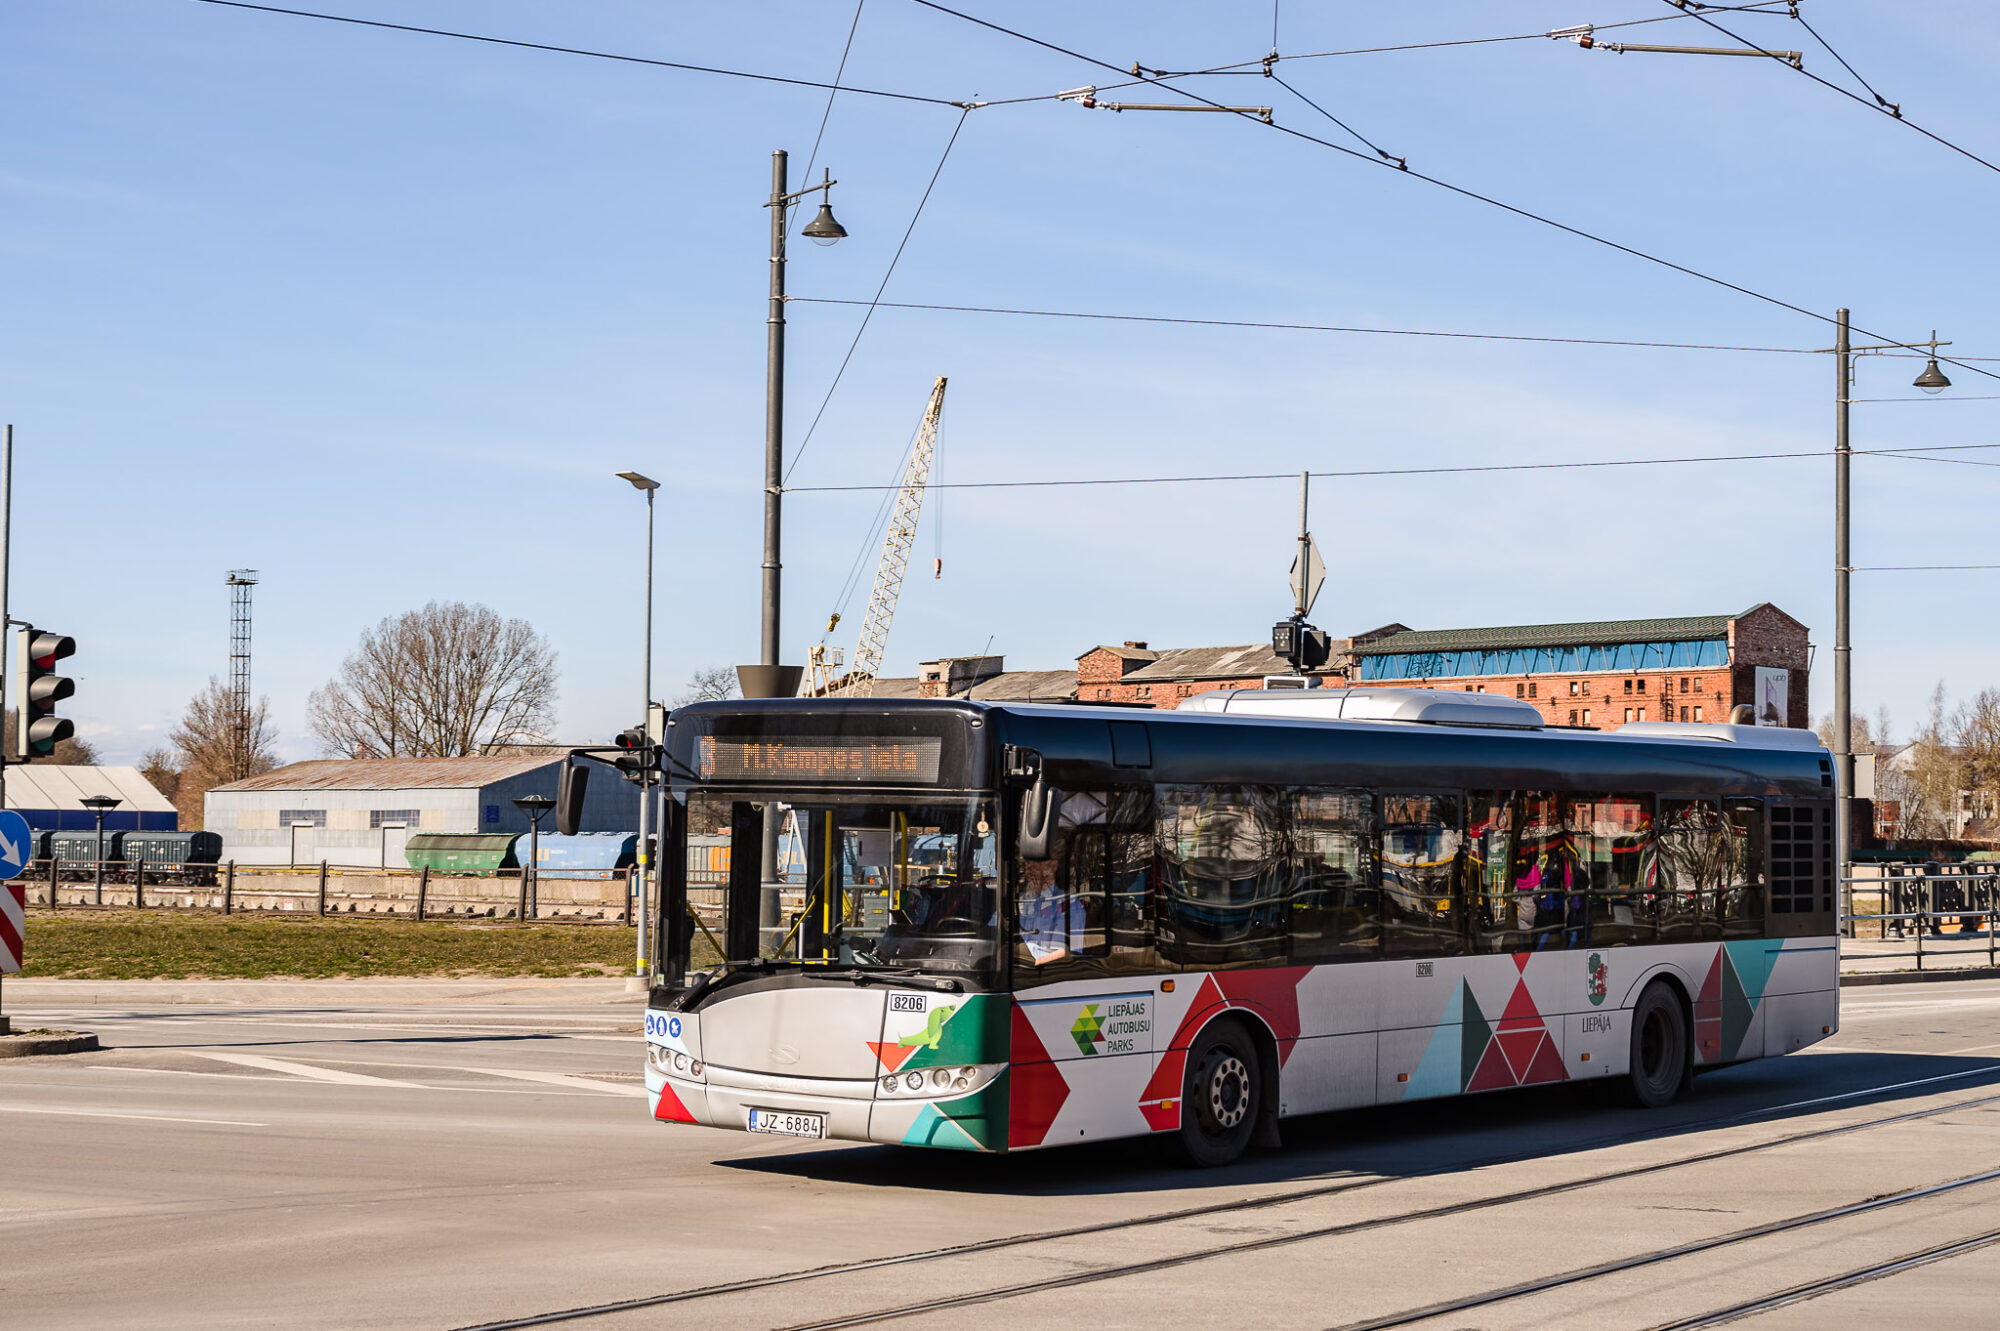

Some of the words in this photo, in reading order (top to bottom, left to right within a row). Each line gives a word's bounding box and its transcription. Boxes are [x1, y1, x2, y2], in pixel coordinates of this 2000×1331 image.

[700, 736, 716, 775] 3
[871, 744, 918, 770] iela
[894, 996, 923, 1010] 8206
[1108, 1002, 1145, 1017] LIEPĀJAS
[1107, 1020, 1151, 1035] AUTOBUSU
[1582, 1014, 1611, 1033] LIEPĀJA
[1107, 1039, 1134, 1053] PARKS
[760, 1114, 818, 1133] JZ-6884
